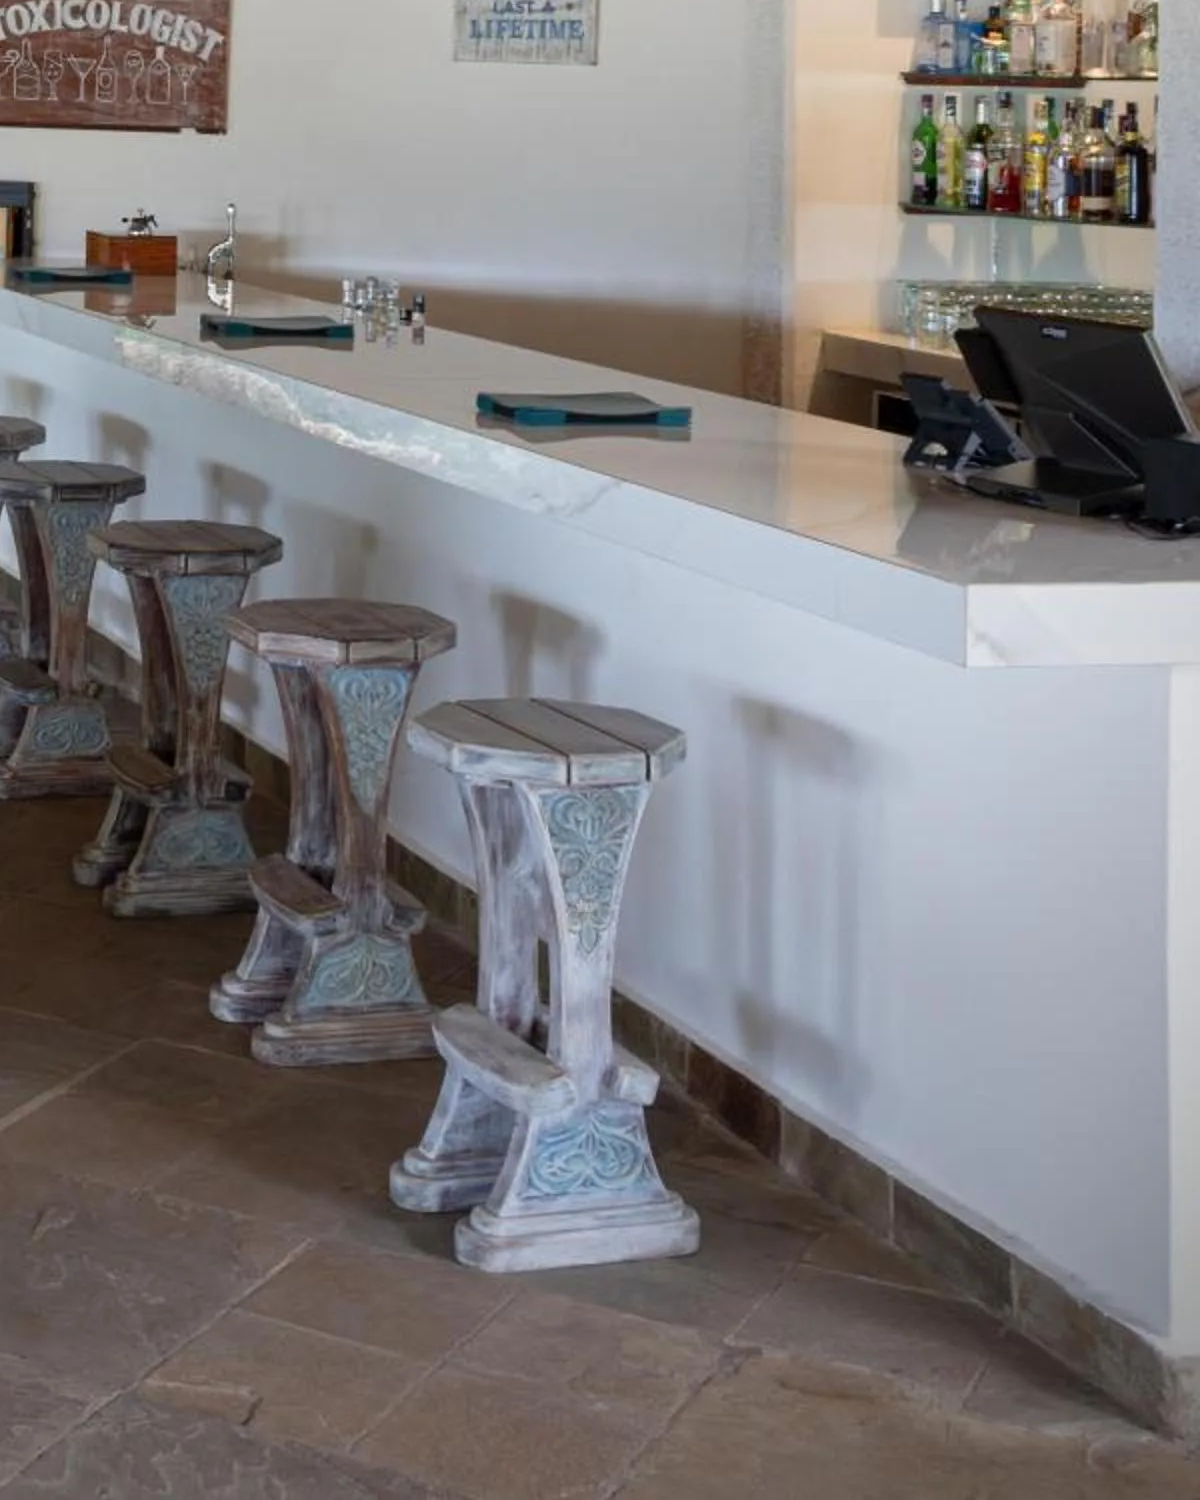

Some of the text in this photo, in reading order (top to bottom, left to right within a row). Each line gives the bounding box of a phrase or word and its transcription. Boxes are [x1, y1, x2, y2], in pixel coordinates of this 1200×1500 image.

[492, 0, 556, 15] LAST A
[468, 18, 585, 41] LIFETIME
